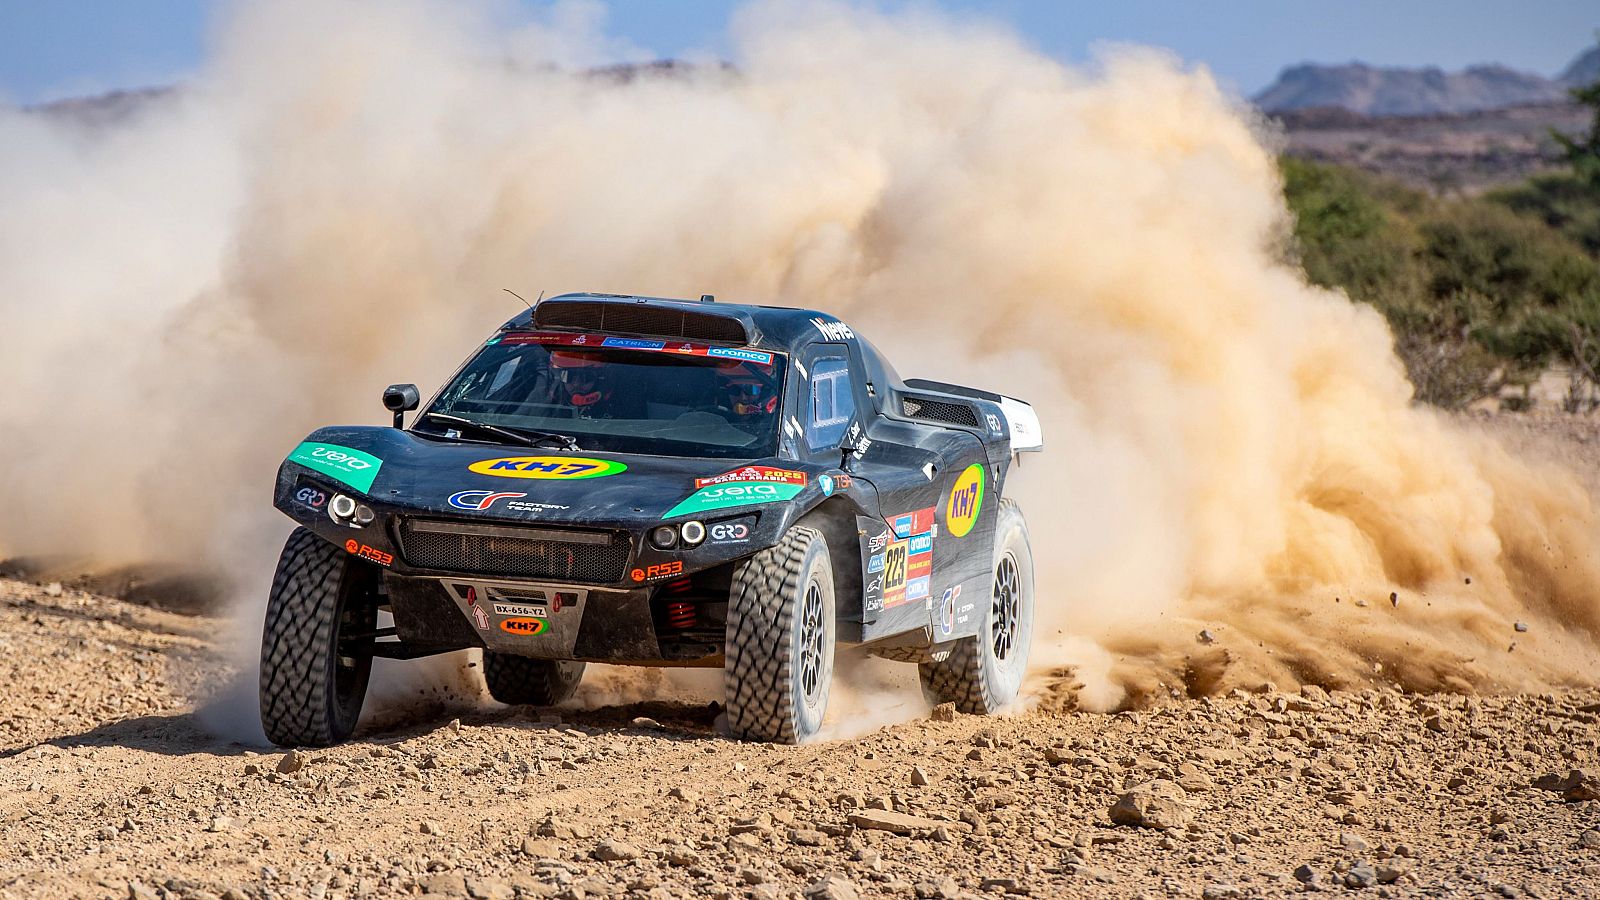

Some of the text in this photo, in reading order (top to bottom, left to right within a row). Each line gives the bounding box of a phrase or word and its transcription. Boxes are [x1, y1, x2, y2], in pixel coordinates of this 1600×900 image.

[809, 317, 855, 341] Nieves
[712, 347, 767, 361] aramco
[312, 447, 373, 469] vera
[714, 476, 747, 484] SAUDI
[765, 471, 802, 479] 2025
[697, 485, 778, 498] vera
[506, 505, 543, 513] TEAM
[508, 501, 570, 511] FACTORY
[359, 544, 394, 564] R53
[647, 560, 683, 577] R53
[885, 546, 905, 590] 223
[496, 605, 545, 616] BX-656-YZ
